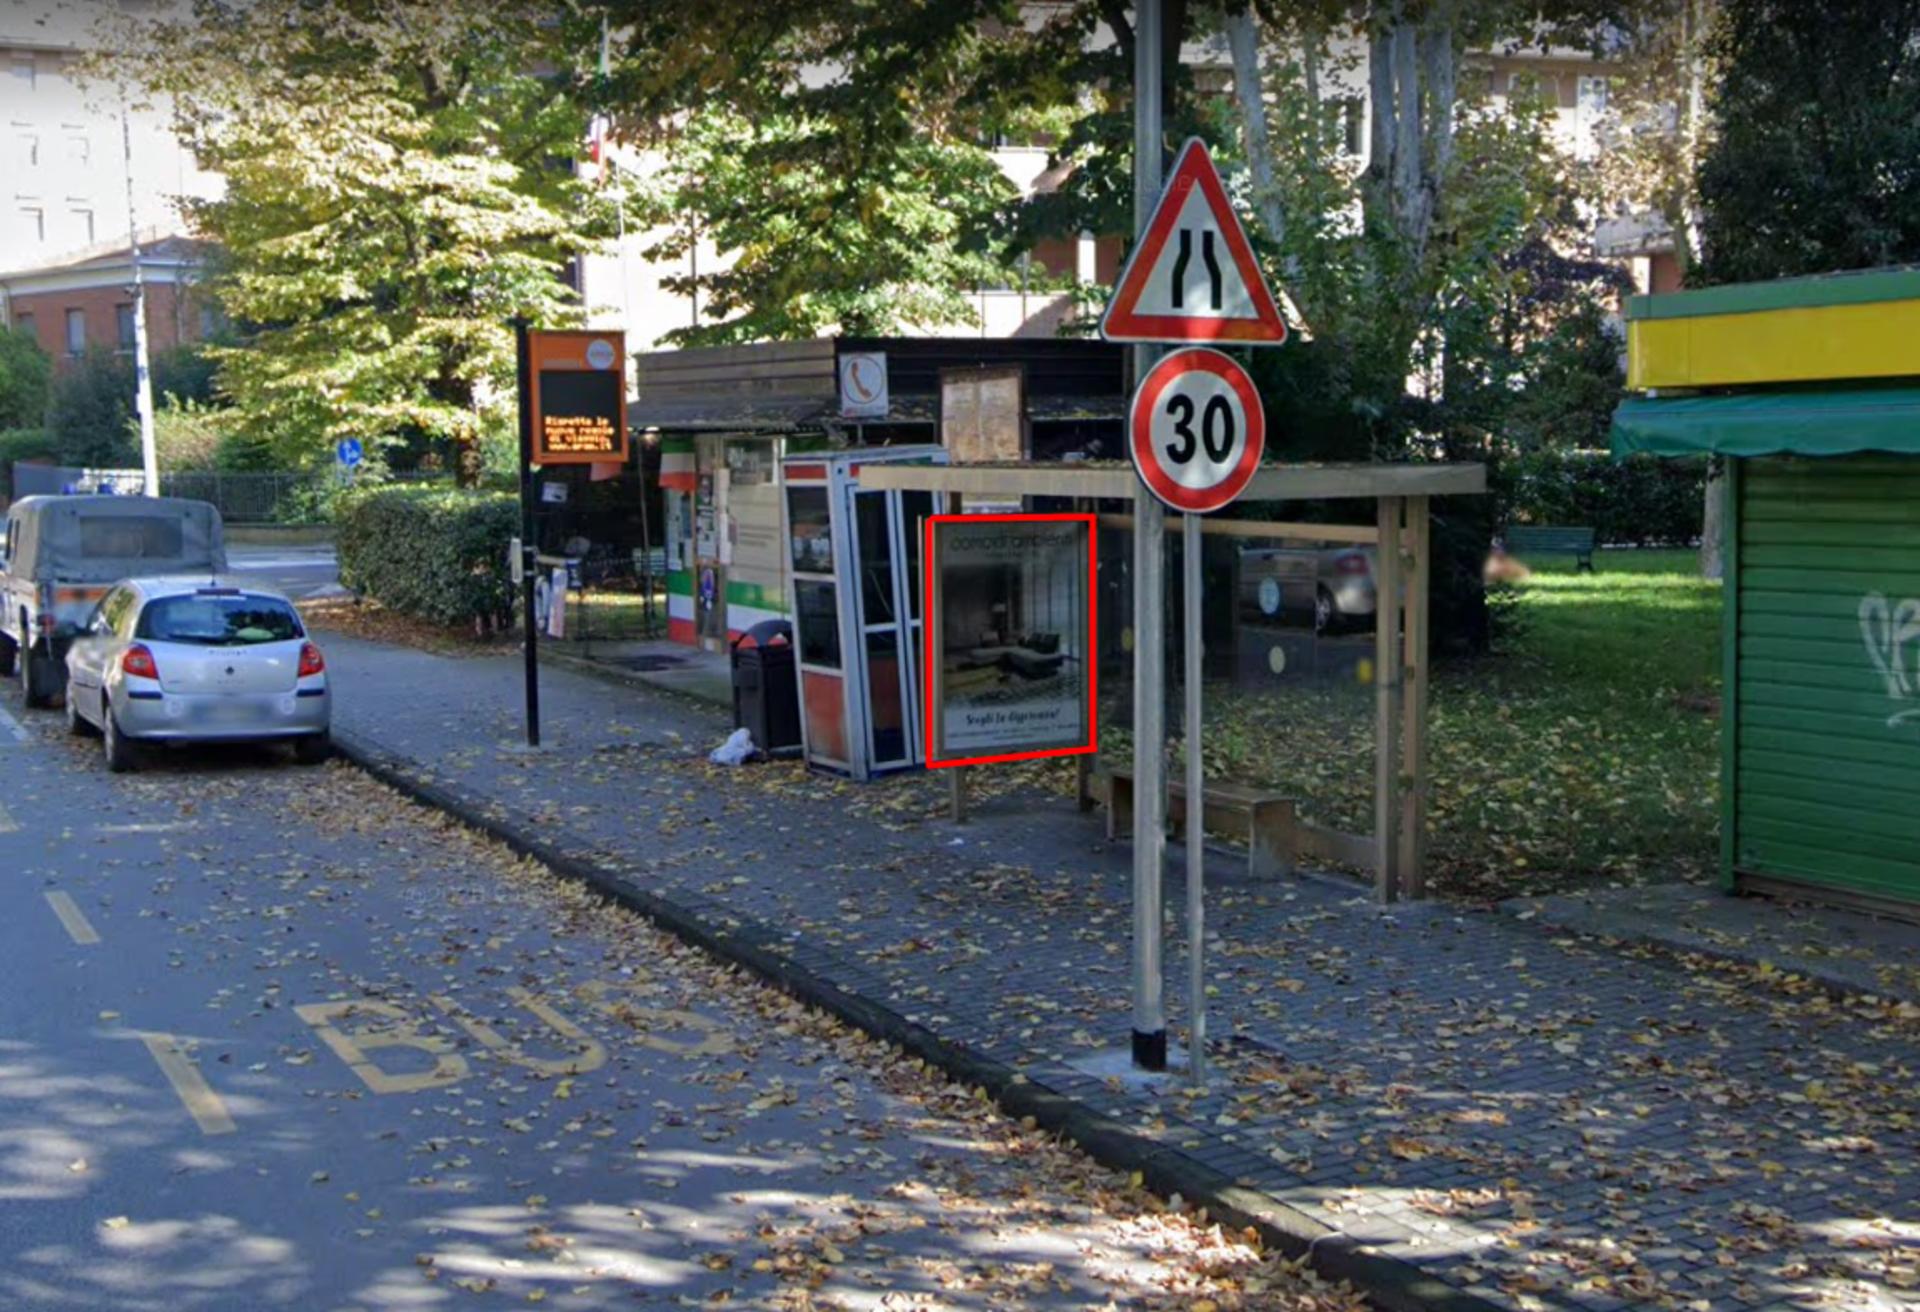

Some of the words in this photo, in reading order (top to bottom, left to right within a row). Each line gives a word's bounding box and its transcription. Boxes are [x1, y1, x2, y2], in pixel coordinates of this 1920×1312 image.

[597, 416, 609, 426] le
[1166, 393, 1235, 465] 30
[294, 980, 737, 1095] BUS
